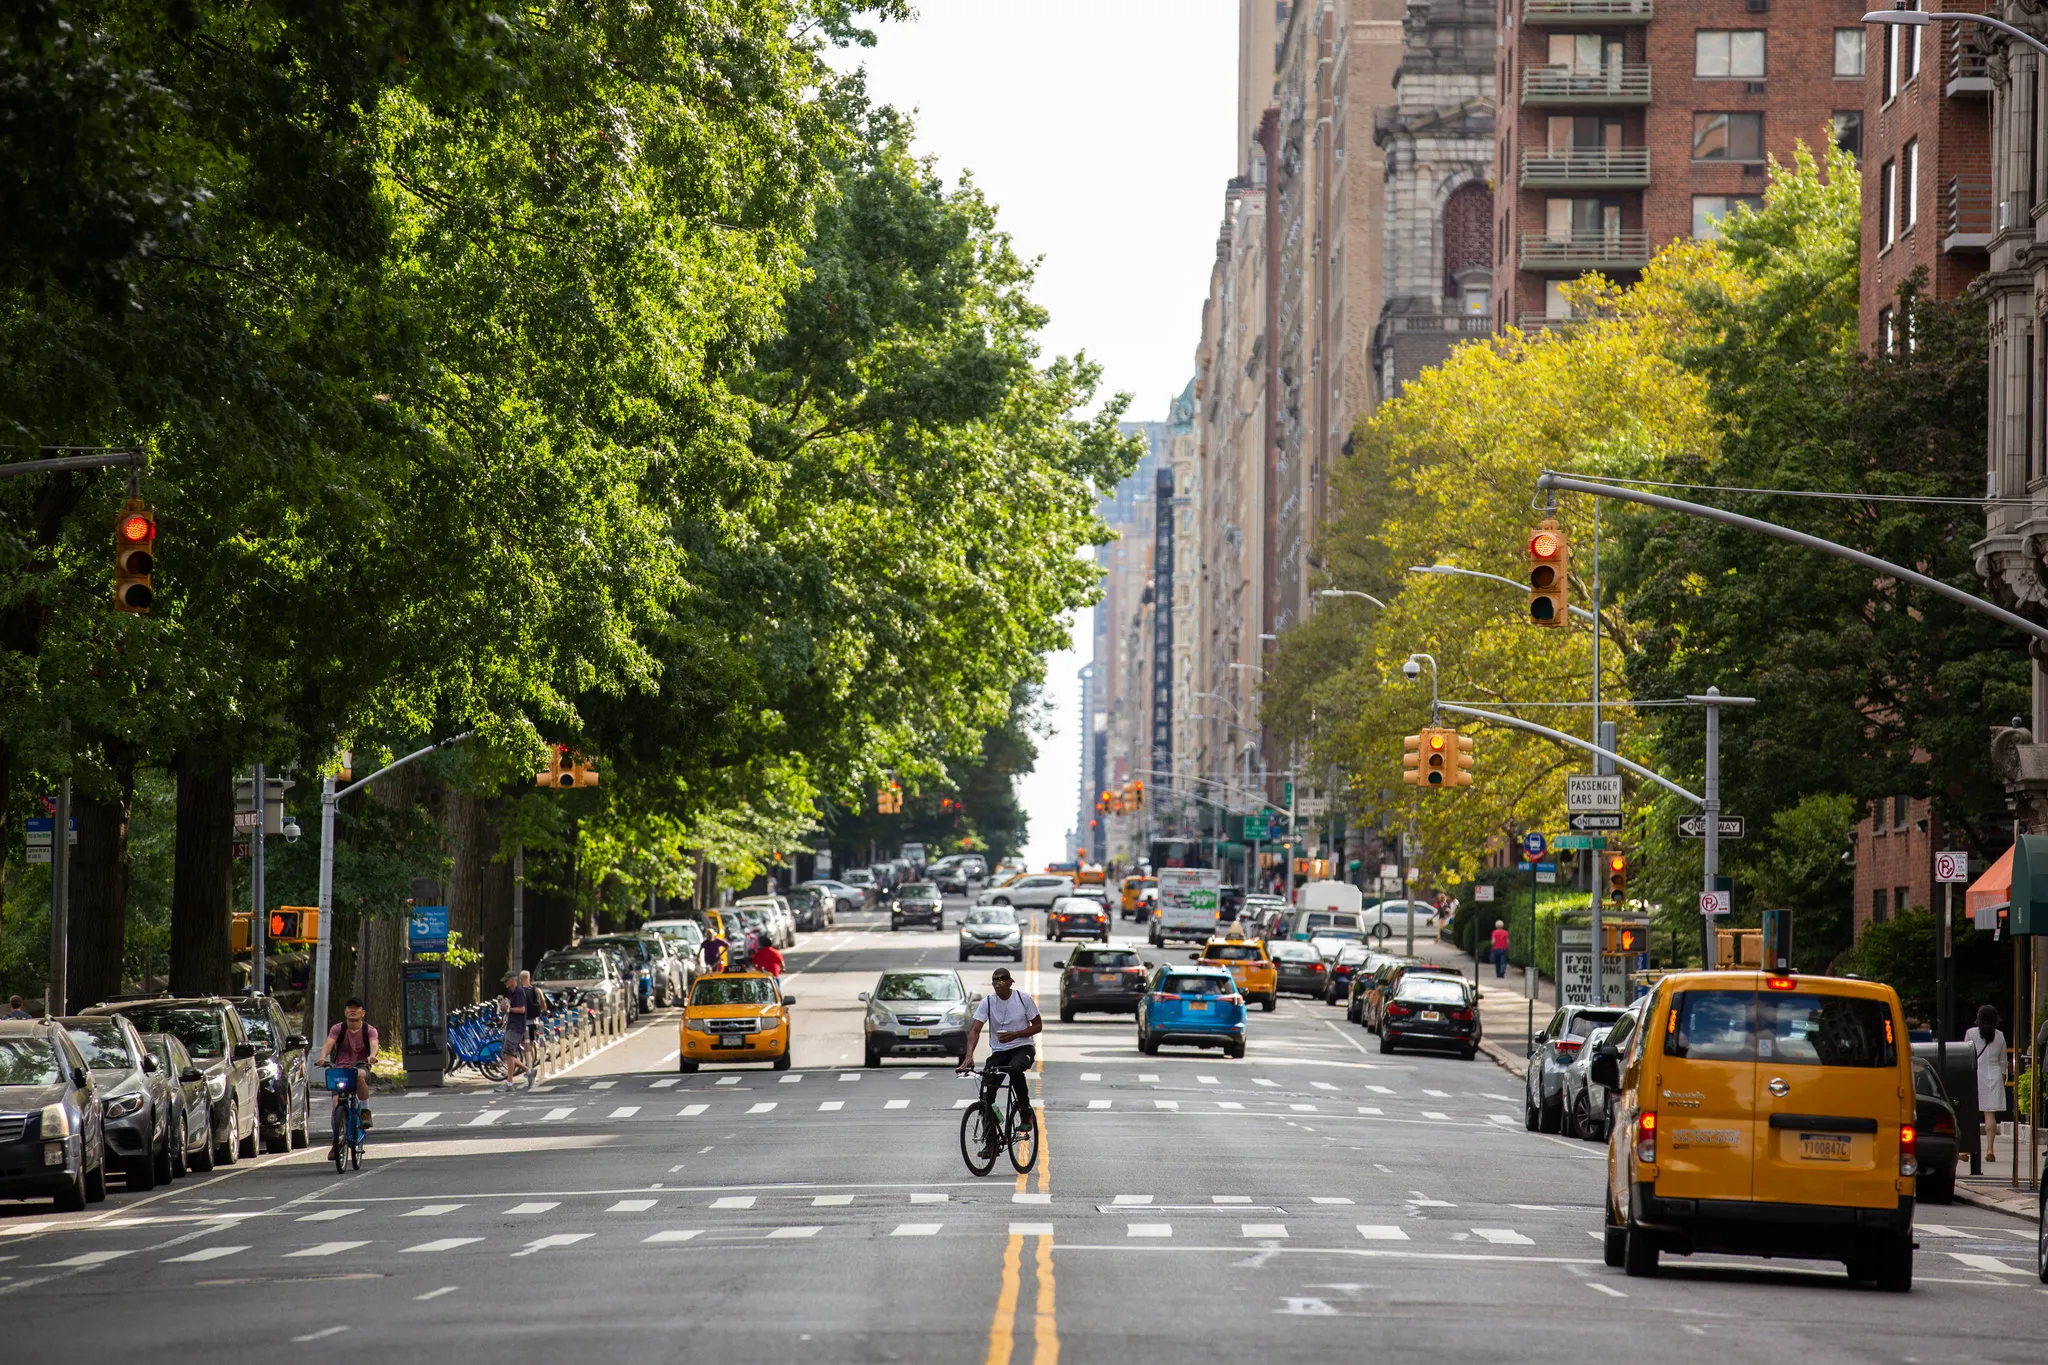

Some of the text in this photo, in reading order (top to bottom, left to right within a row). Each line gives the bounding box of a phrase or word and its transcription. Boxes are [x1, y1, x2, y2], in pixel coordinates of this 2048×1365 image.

[1571, 780, 1618, 791] PASSENGER
[1571, 794, 1618, 805] CARS ONLY
[1687, 822, 1738, 831] ONE WAY
[1565, 955, 1574, 964] IF
[1603, 956, 1621, 965] EEP
[1608, 984, 1622, 994] AD,
[1568, 994, 1587, 1002] YOU
[1804, 1141, 1847, 1155] Y100847C
